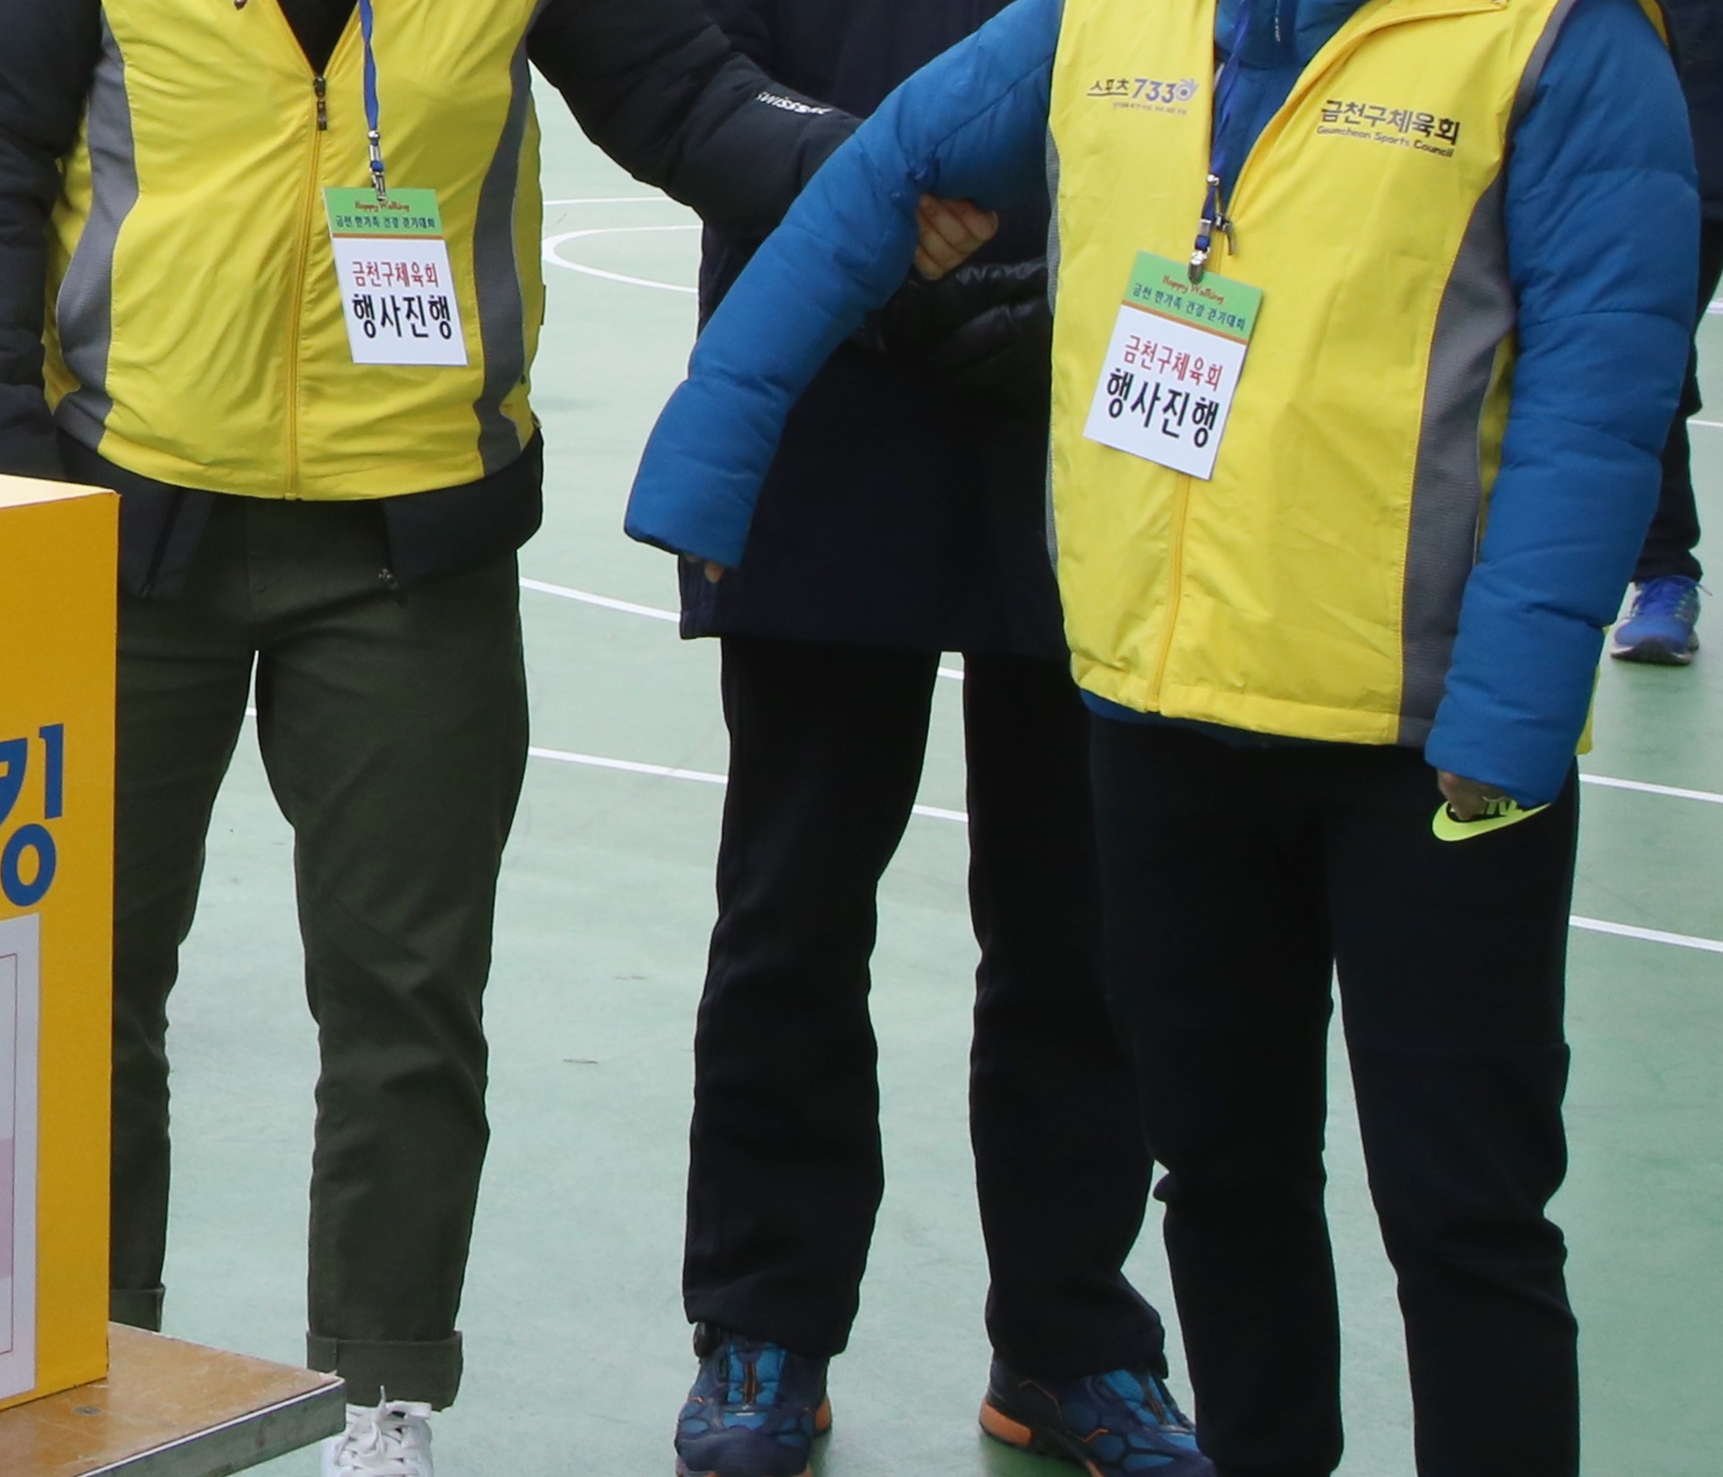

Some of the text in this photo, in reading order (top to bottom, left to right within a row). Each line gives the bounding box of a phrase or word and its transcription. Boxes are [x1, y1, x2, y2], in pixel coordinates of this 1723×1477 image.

[1316, 125, 1455, 158] Geumcheon Sports Council
[1321, 99, 1461, 146] 금천구체육회
[352, 261, 439, 288] 금천구체육회
[1162, 274, 1225, 305] Happy Walking
[352, 294, 452, 340] 행사진행
[1132, 282, 1247, 332] 금천 한가족 건강 걷기대회
[1123, 334, 1223, 392] 금천구체육회
[1106, 367, 1220, 448] 행사진행
